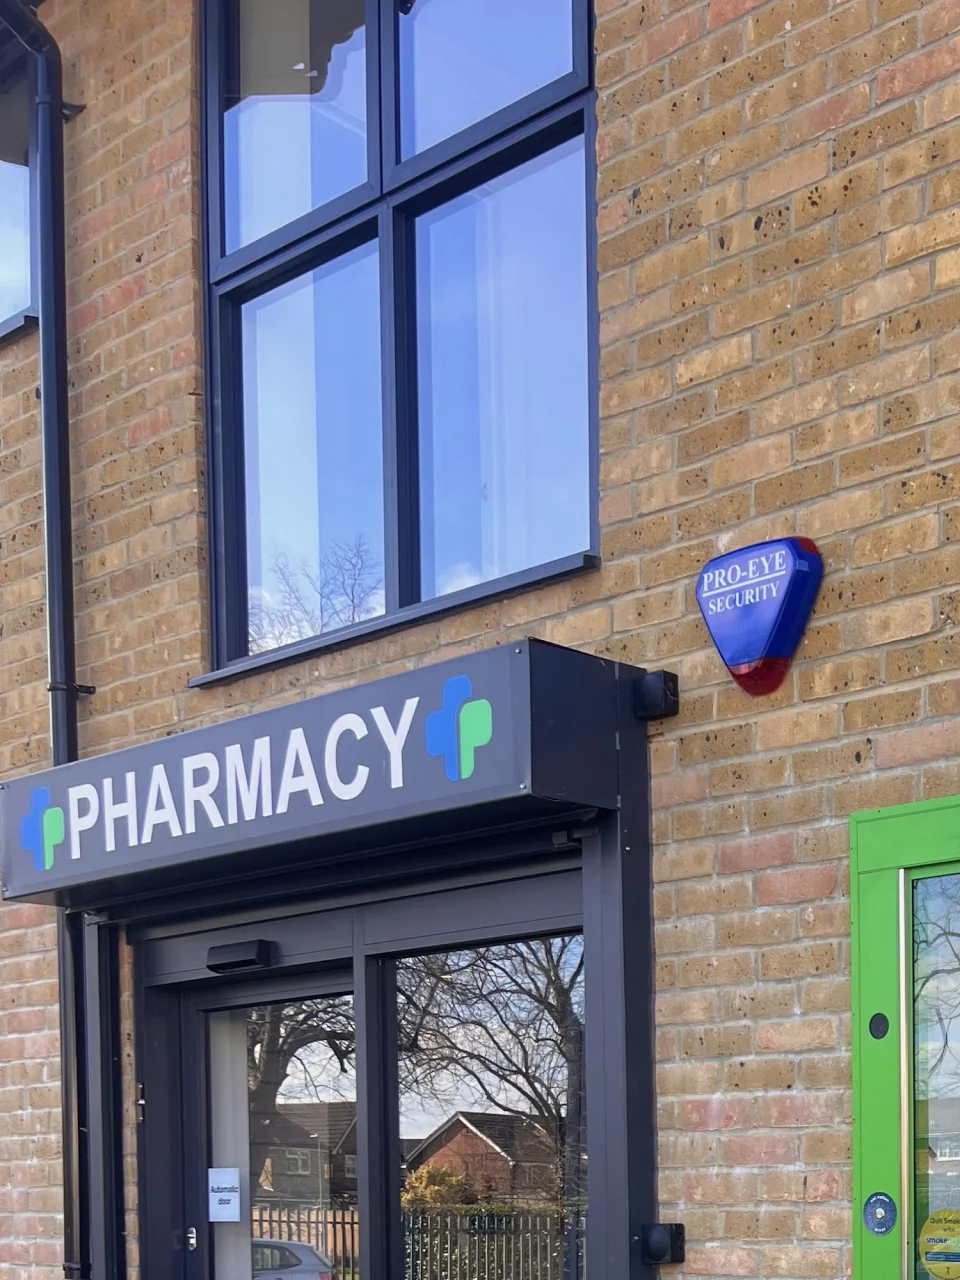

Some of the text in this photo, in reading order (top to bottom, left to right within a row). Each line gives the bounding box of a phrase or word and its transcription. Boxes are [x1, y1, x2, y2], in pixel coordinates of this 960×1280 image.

[702, 550, 787, 592] PRO-EYE
[708, 581, 780, 615] SECURITY
[68, 696, 420, 860] PHARMACY
